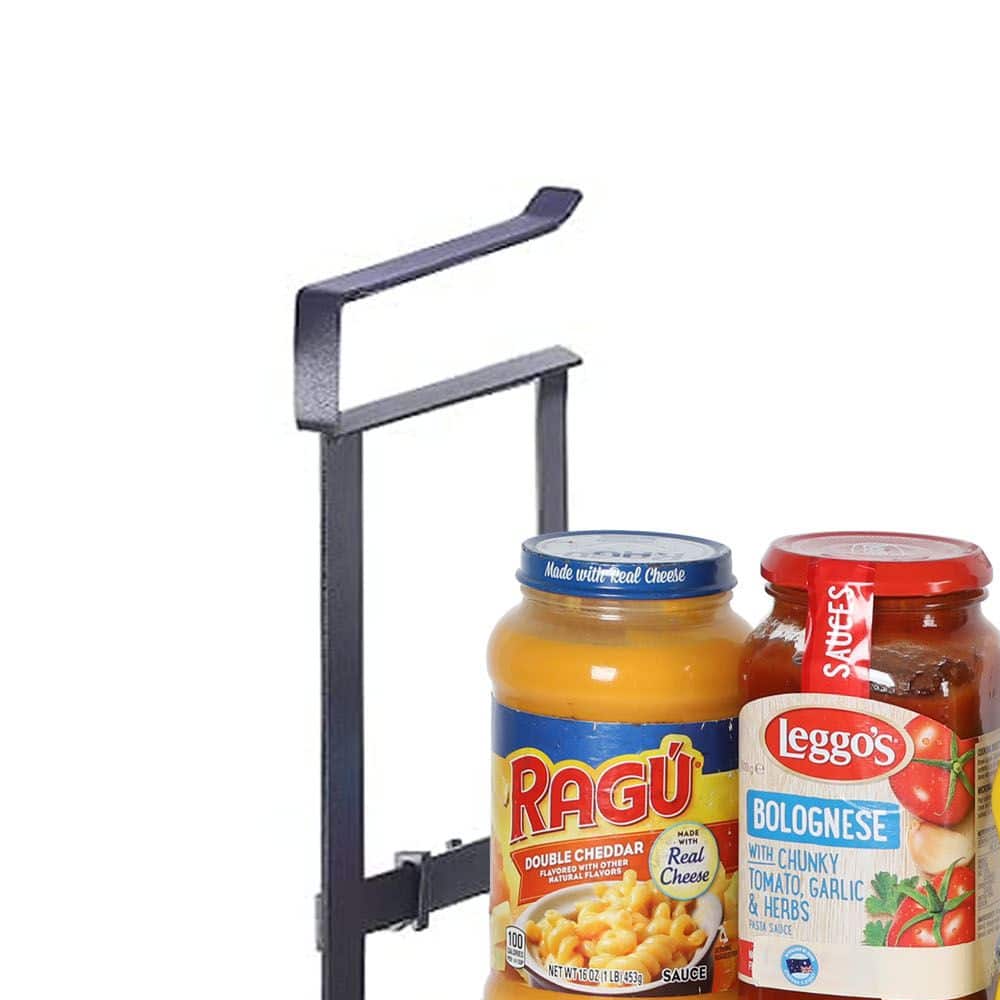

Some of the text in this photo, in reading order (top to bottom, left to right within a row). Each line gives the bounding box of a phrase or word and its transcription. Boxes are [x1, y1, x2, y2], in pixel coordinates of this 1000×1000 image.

[545, 561, 687, 585] Made with Real Cheese
[823, 584, 850, 679] SAUCES
[779, 718, 896, 766] Leggo's
[509, 741, 694, 845] RAGÚ
[753, 798, 888, 842] BOLOGNESE
[677, 829, 700, 838] MADE
[679, 837, 699, 846] WITH
[525, 841, 645, 869] DOUBLE CHEDDAR
[667, 846, 705, 866] Real
[748, 843, 839, 875] WITH CHUNKY
[540, 859, 629, 878] FLAVORED WITH OTHER
[549, 868, 622, 883] NATURAL FLAVORS
[660, 867, 710, 886] Cheese
[749, 867, 865, 901] TOMATO, GARLIC
[748, 893, 810, 922] & HERBS
[748, 919, 793, 936] PASTA SAUCE
[508, 931, 523, 949] 100
[548, 964, 562, 978] NET
[564, 967, 577, 979] WT
[579, 969, 587, 981] 16
[589, 970, 600, 982] OZ
[662, 965, 707, 982] SAUCE
